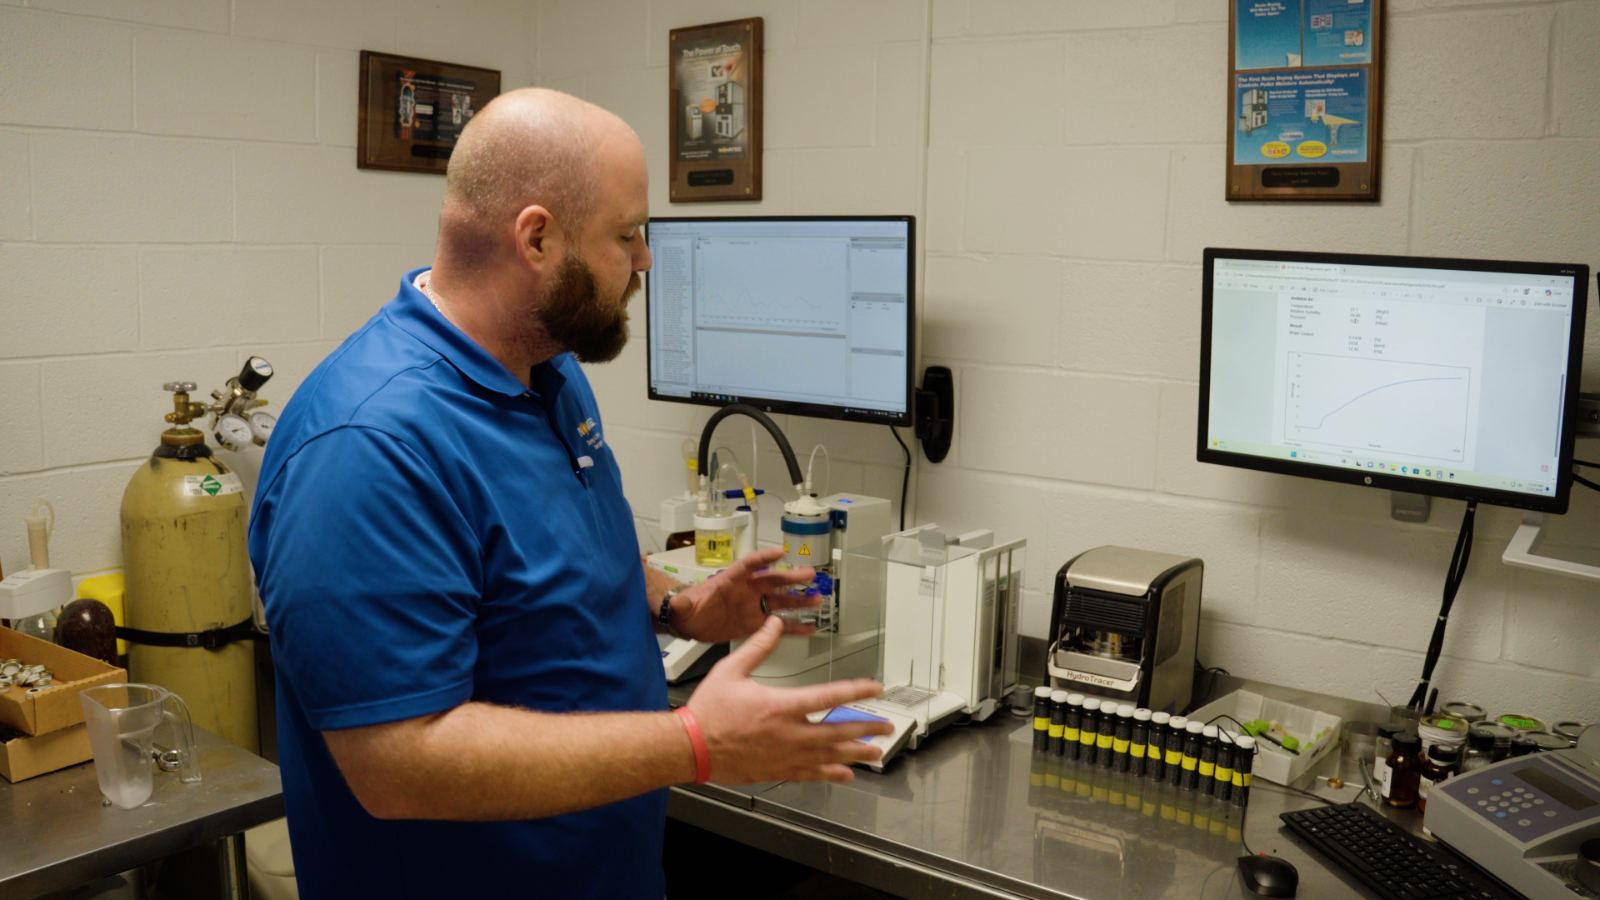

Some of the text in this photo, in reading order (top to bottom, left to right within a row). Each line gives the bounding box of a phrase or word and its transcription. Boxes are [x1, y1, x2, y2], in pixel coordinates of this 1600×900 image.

[682, 48, 694, 57] The
[694, 47, 714, 57] Power
[721, 43, 741, 54] Touch
[1066, 671, 1115, 686] HydroTracer
